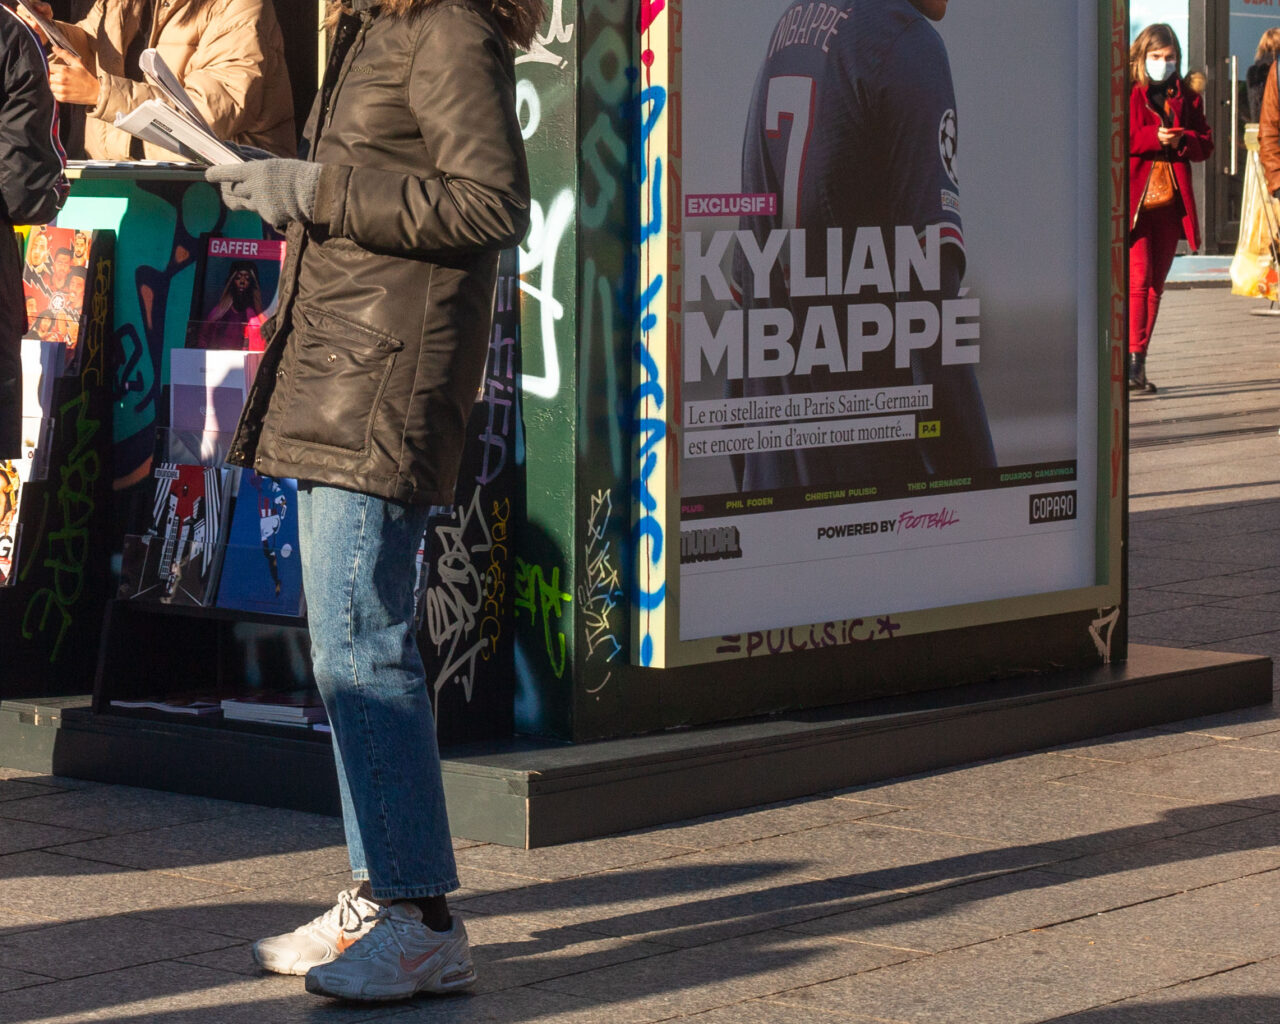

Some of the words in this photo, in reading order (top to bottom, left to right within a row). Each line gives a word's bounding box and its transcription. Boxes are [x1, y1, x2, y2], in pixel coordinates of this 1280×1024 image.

[765, 73, 817, 229] 7
[210, 239, 259, 257] GAFFER
[684, 225, 941, 302] KYLIAN
[684, 287, 980, 382] MBAPPÉ
[688, 406, 706, 425] Le
[709, 403, 728, 423] roi
[730, 398, 782, 422] stellaire
[784, 397, 802, 418] du
[803, 395, 835, 416] Paris
[837, 389, 930, 414] Saint-Germain
[688, 439, 707, 454] est
[709, 435, 754, 454] encore
[757, 427, 783, 450] loin
[830, 427, 854, 445] tout
[805, 490, 845, 501] CHRISTIAN
[848, 487, 878, 497] PULISIC
[908, 483, 927, 491] THEO
[929, 478, 972, 488] HERNANDEZ
[726, 500, 744, 509] PHIL
[747, 497, 774, 507] FODEN
[1032, 495, 1074, 519] COPA90
[817, 522, 878, 539] POWERED
[880, 520, 896, 532] BY
